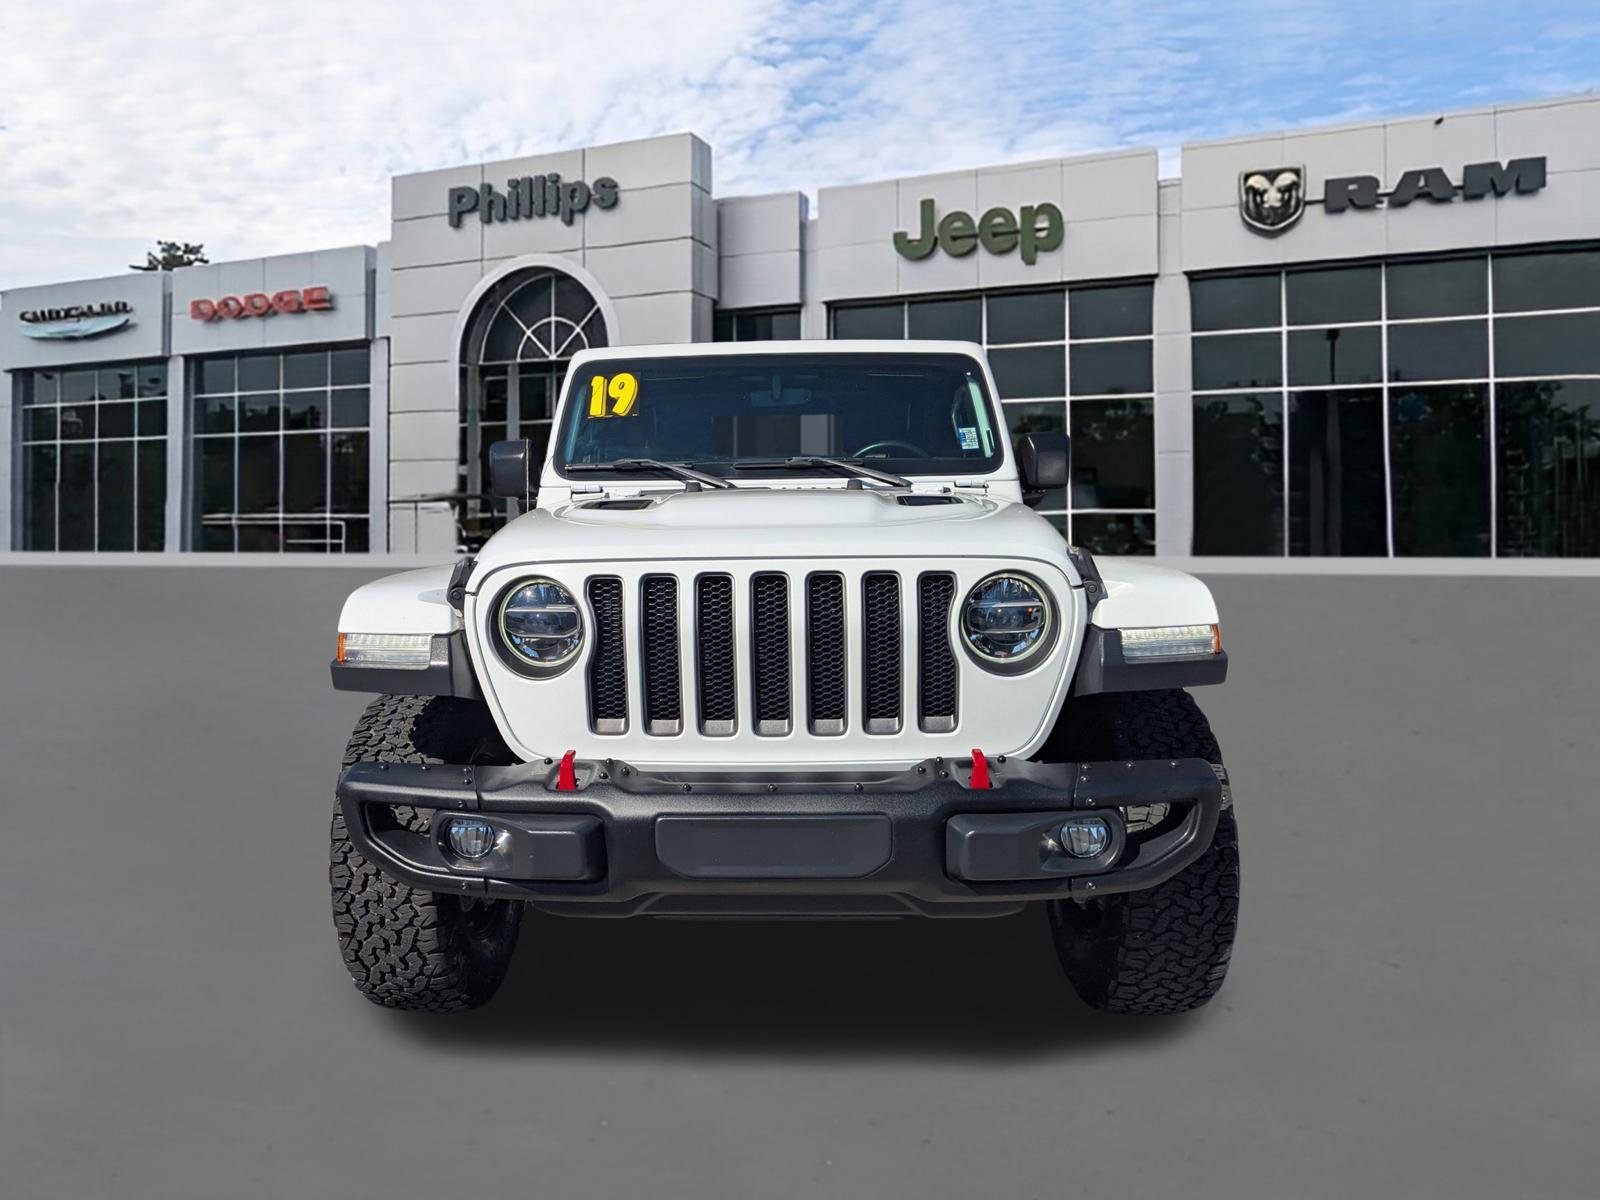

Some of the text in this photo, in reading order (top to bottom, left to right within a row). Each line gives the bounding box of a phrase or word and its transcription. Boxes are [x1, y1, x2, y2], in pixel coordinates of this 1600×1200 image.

[448, 172, 619, 229] Phillips
[1324, 156, 1547, 214] RAM
[893, 198, 1065, 266] Jeep
[190, 286, 331, 322] DODGE
[588, 372, 639, 417] 19
